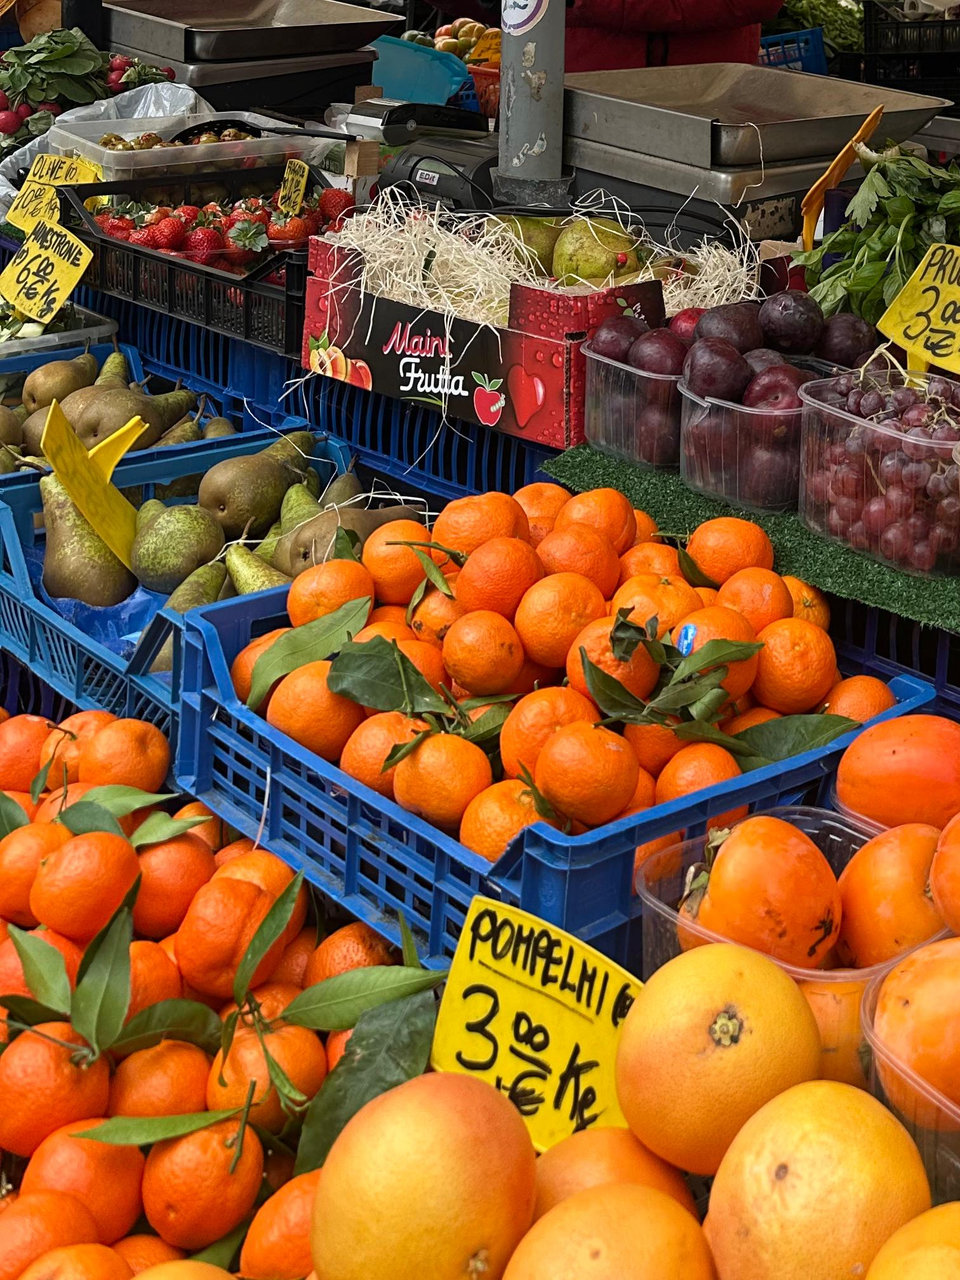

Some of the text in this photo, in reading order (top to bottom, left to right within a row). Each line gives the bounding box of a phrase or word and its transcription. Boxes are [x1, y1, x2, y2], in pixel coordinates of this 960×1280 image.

[32, 154, 67, 181] OLIVE
[22, 219, 84, 268] MINESTRONE
[399, 356, 470, 398] Frutta
[468, 907, 610, 1017] POMPELMI
